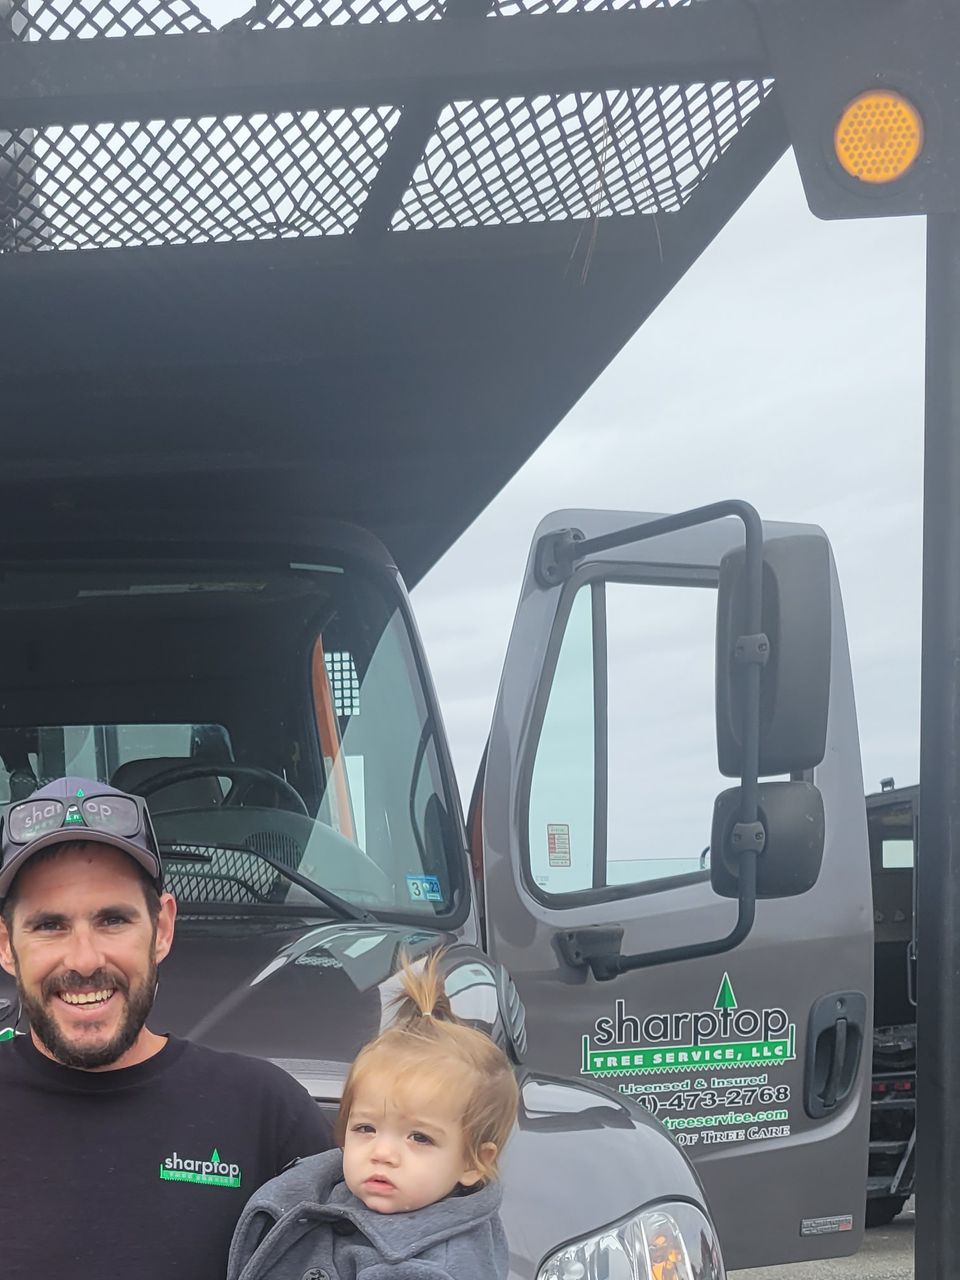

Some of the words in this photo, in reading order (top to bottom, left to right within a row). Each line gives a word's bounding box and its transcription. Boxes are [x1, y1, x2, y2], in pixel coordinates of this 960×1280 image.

[411, 881, 421, 897] 3
[594, 999, 788, 1046] sharptop
[593, 1055, 644, 1068] TREE
[653, 1049, 743, 1064] SERVICE,
[751, 1046, 784, 1058] LLC
[619, 1080, 691, 1095] Licensed
[694, 1079, 707, 1089] &
[711, 1074, 768, 1088] Insured
[637, 1085, 791, 1115] 4)-473-2768
[662, 1110, 789, 1130] treeservice.com
[700, 1129, 746, 1144] TREE
[747, 1126, 791, 1140] CARE
[164, 1152, 240, 1184] sharptop
